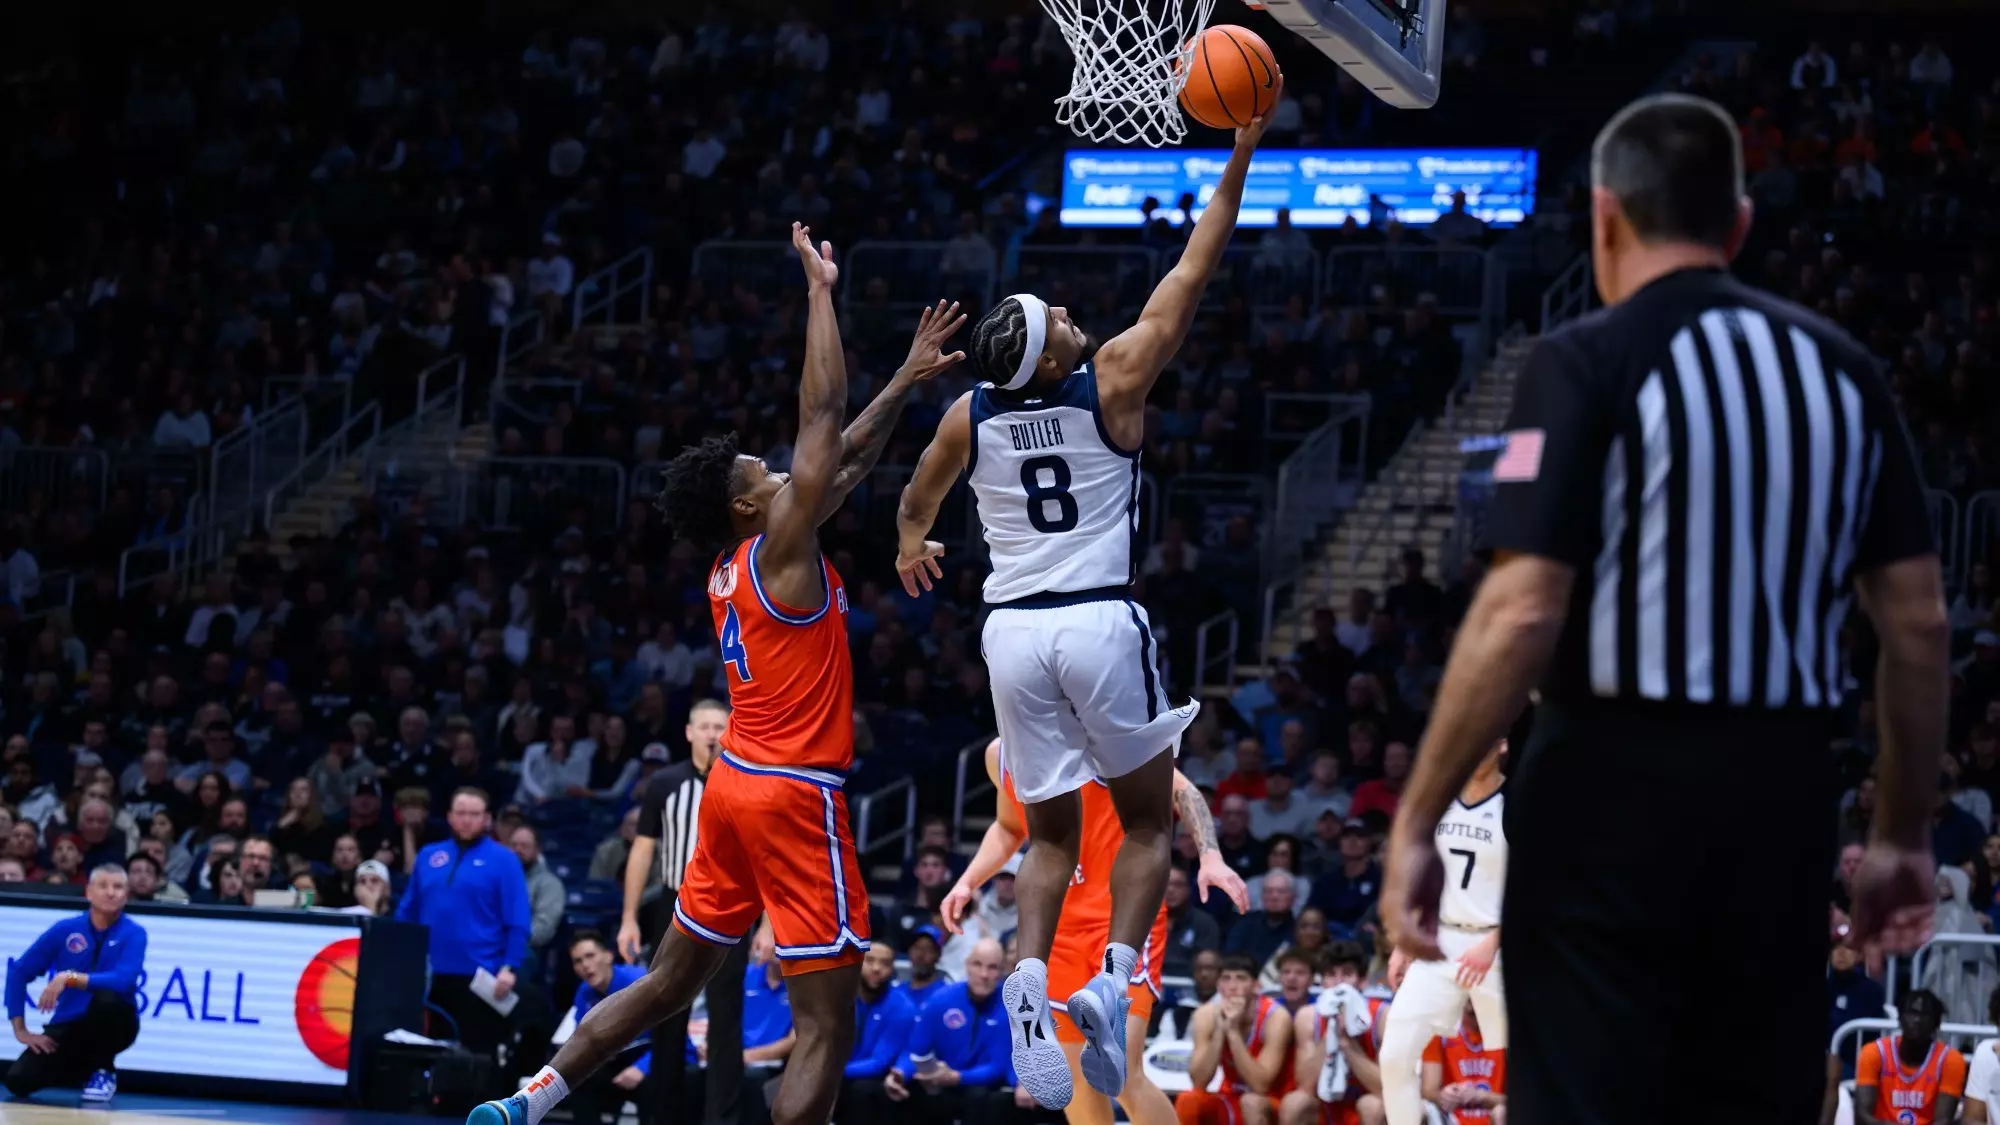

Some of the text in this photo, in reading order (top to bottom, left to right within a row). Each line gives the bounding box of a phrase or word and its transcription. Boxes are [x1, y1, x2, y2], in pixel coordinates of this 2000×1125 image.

[1009, 418, 1064, 451] BUTLER
[1020, 455, 1079, 533] 8
[720, 600, 753, 683] 4
[1437, 823, 1492, 843] BUTLER
[1449, 848, 1476, 890] 7
